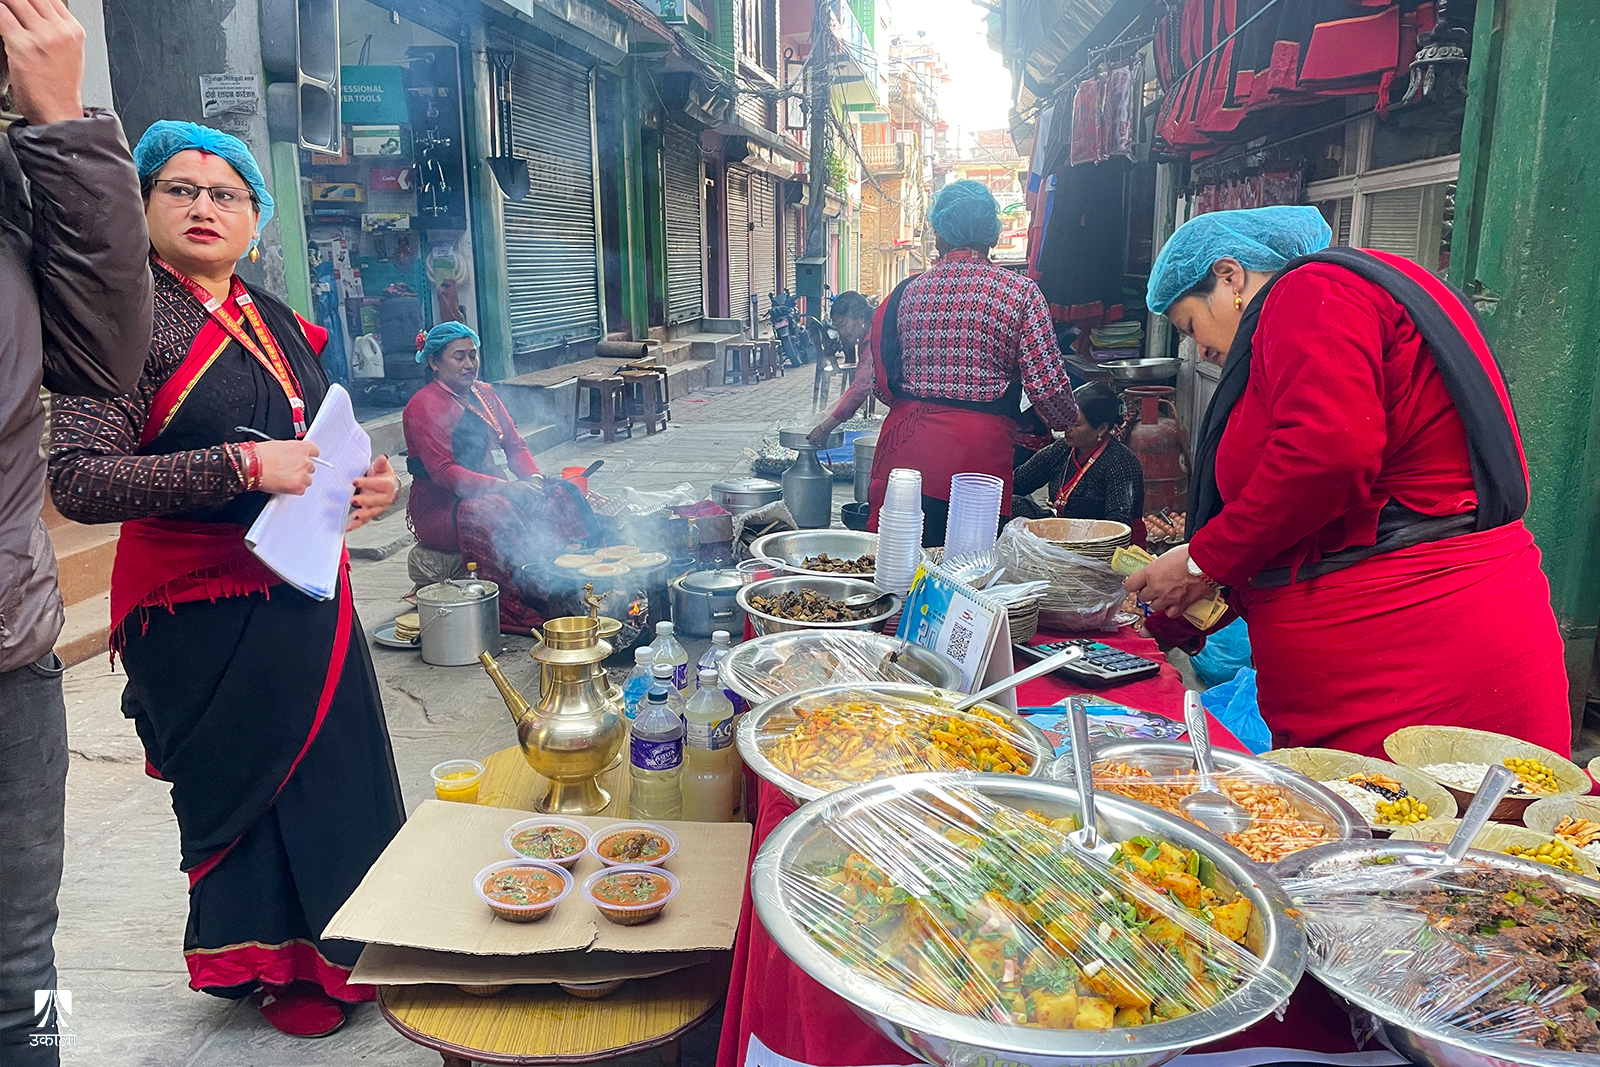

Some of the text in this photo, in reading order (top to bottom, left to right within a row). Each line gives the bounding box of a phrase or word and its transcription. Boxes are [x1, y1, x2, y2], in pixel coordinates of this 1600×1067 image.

[355, 94, 382, 103] TOOLS
[168, 266, 186, 283] Food
[186, 279, 211, 301] Newari
[217, 308, 241, 333] महोत्सव
[655, 749, 676, 762] AQUA
